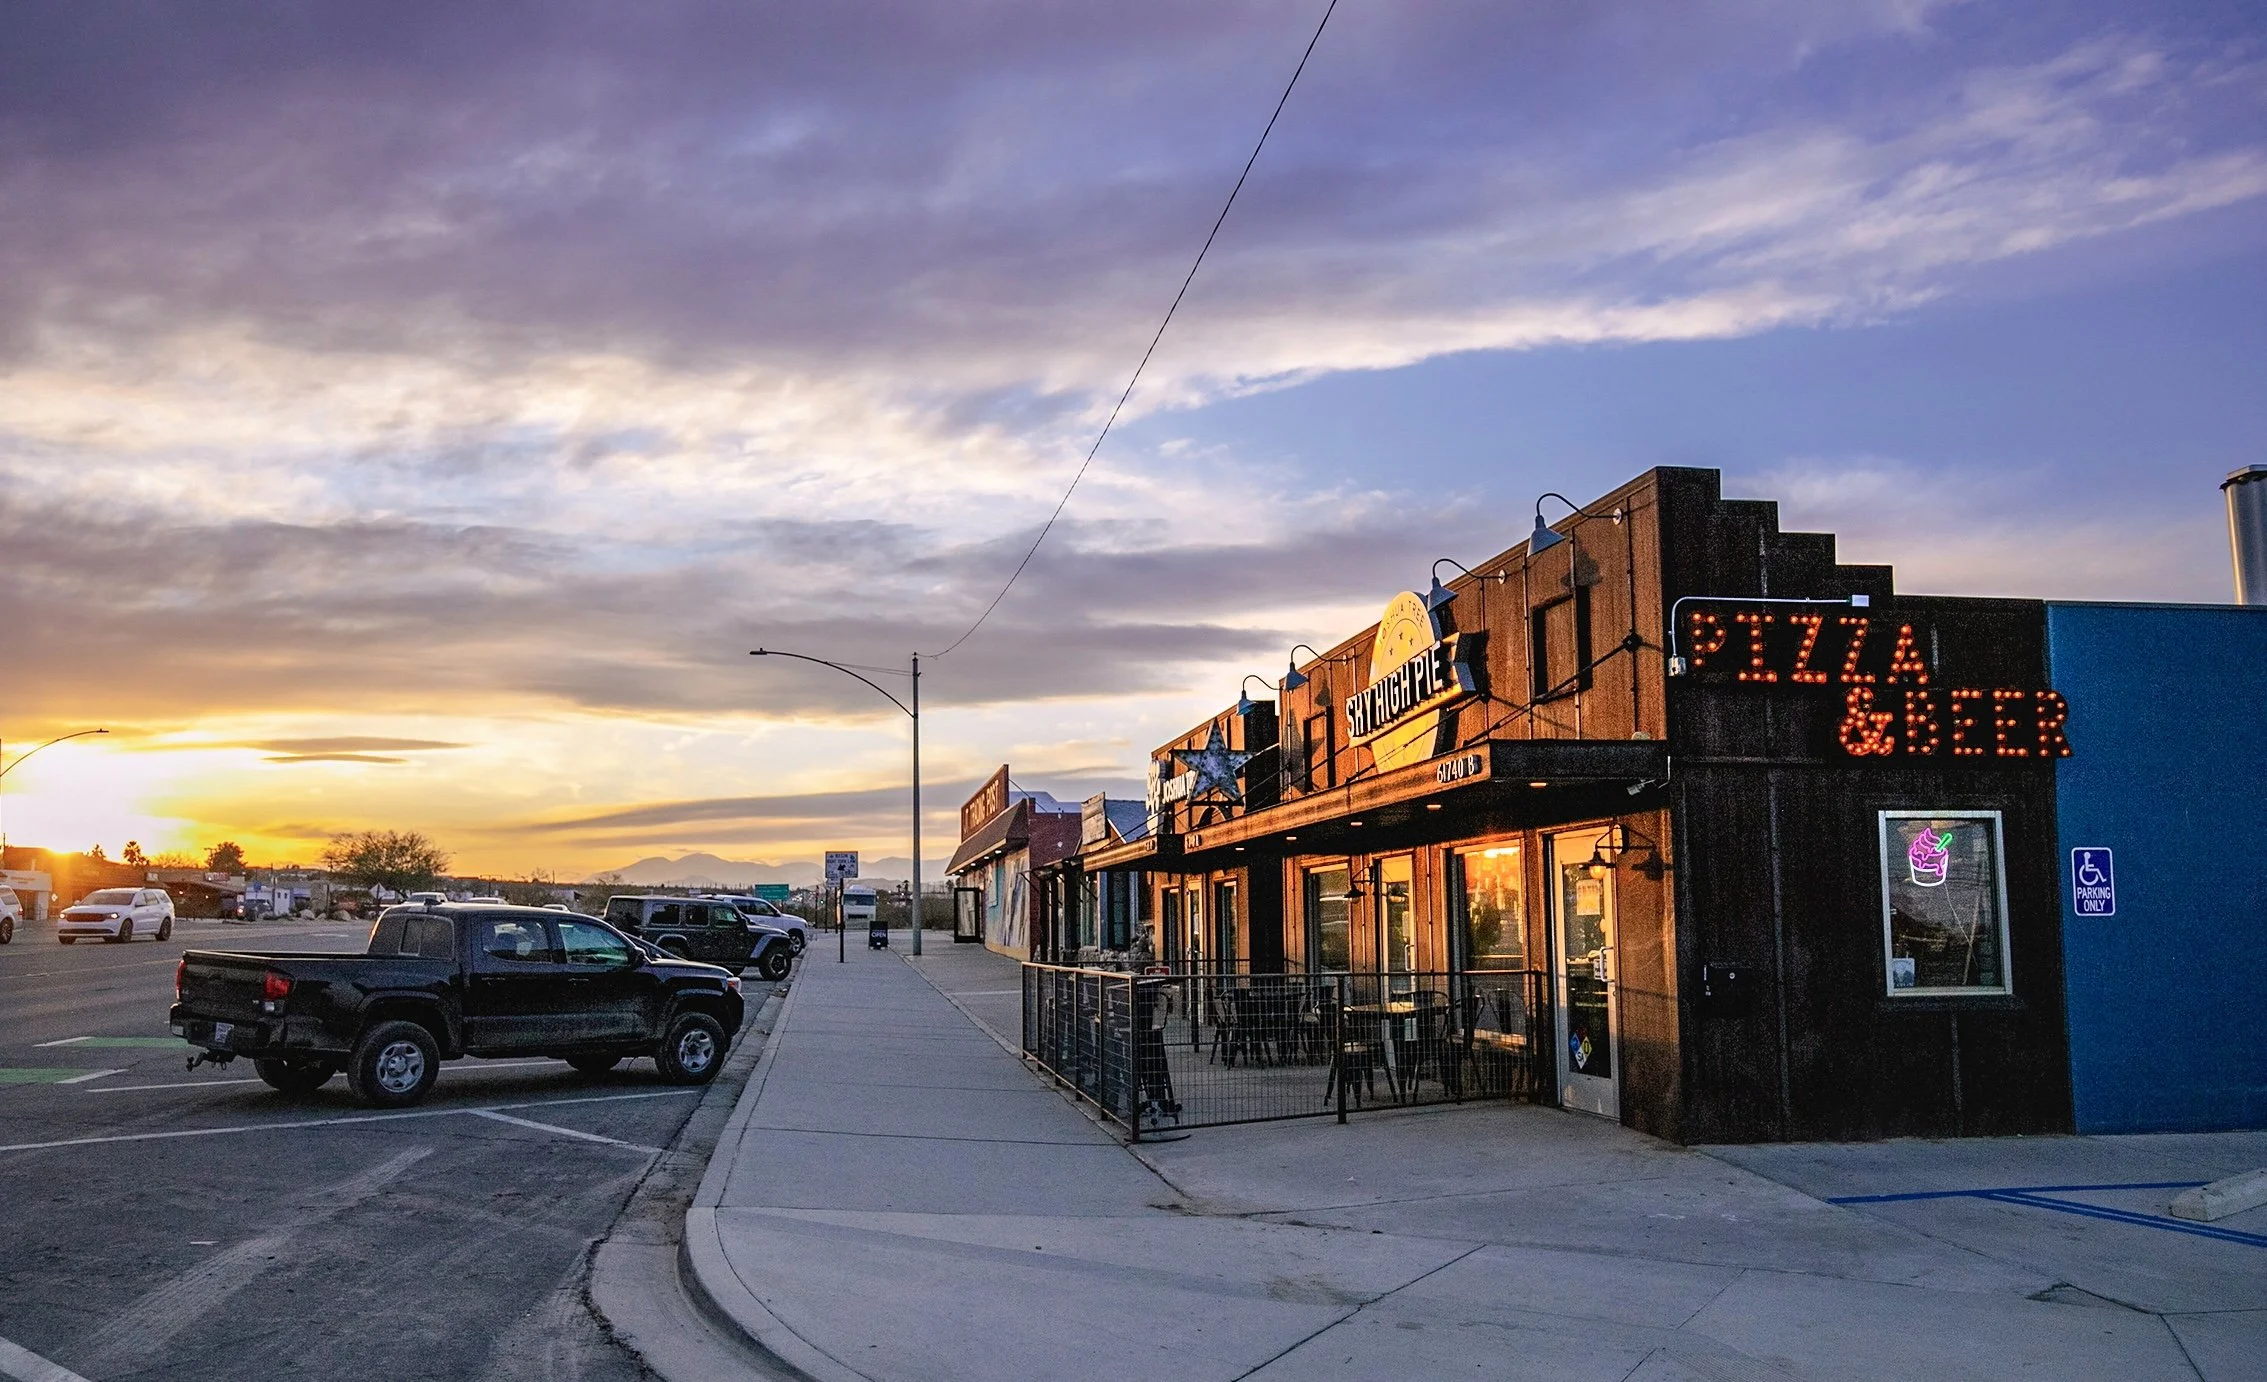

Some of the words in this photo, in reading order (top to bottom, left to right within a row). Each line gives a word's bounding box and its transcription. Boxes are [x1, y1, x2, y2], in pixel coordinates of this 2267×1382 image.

[1408, 600, 1425, 629] TREE
[1690, 611, 1929, 684] PIZZA
[1346, 689, 1372, 737] SKY
[1374, 661, 1411, 726] HIGH
[1414, 641, 1443, 703] PIE
[1436, 758, 1464, 783] 61740
[1467, 754, 1475, 776] B
[986, 779, 999, 817] POST
[1162, 773, 1186, 804] JOSHUA
[2077, 886, 2111, 899] PARKING
[2083, 899, 2105, 912] ONLY
